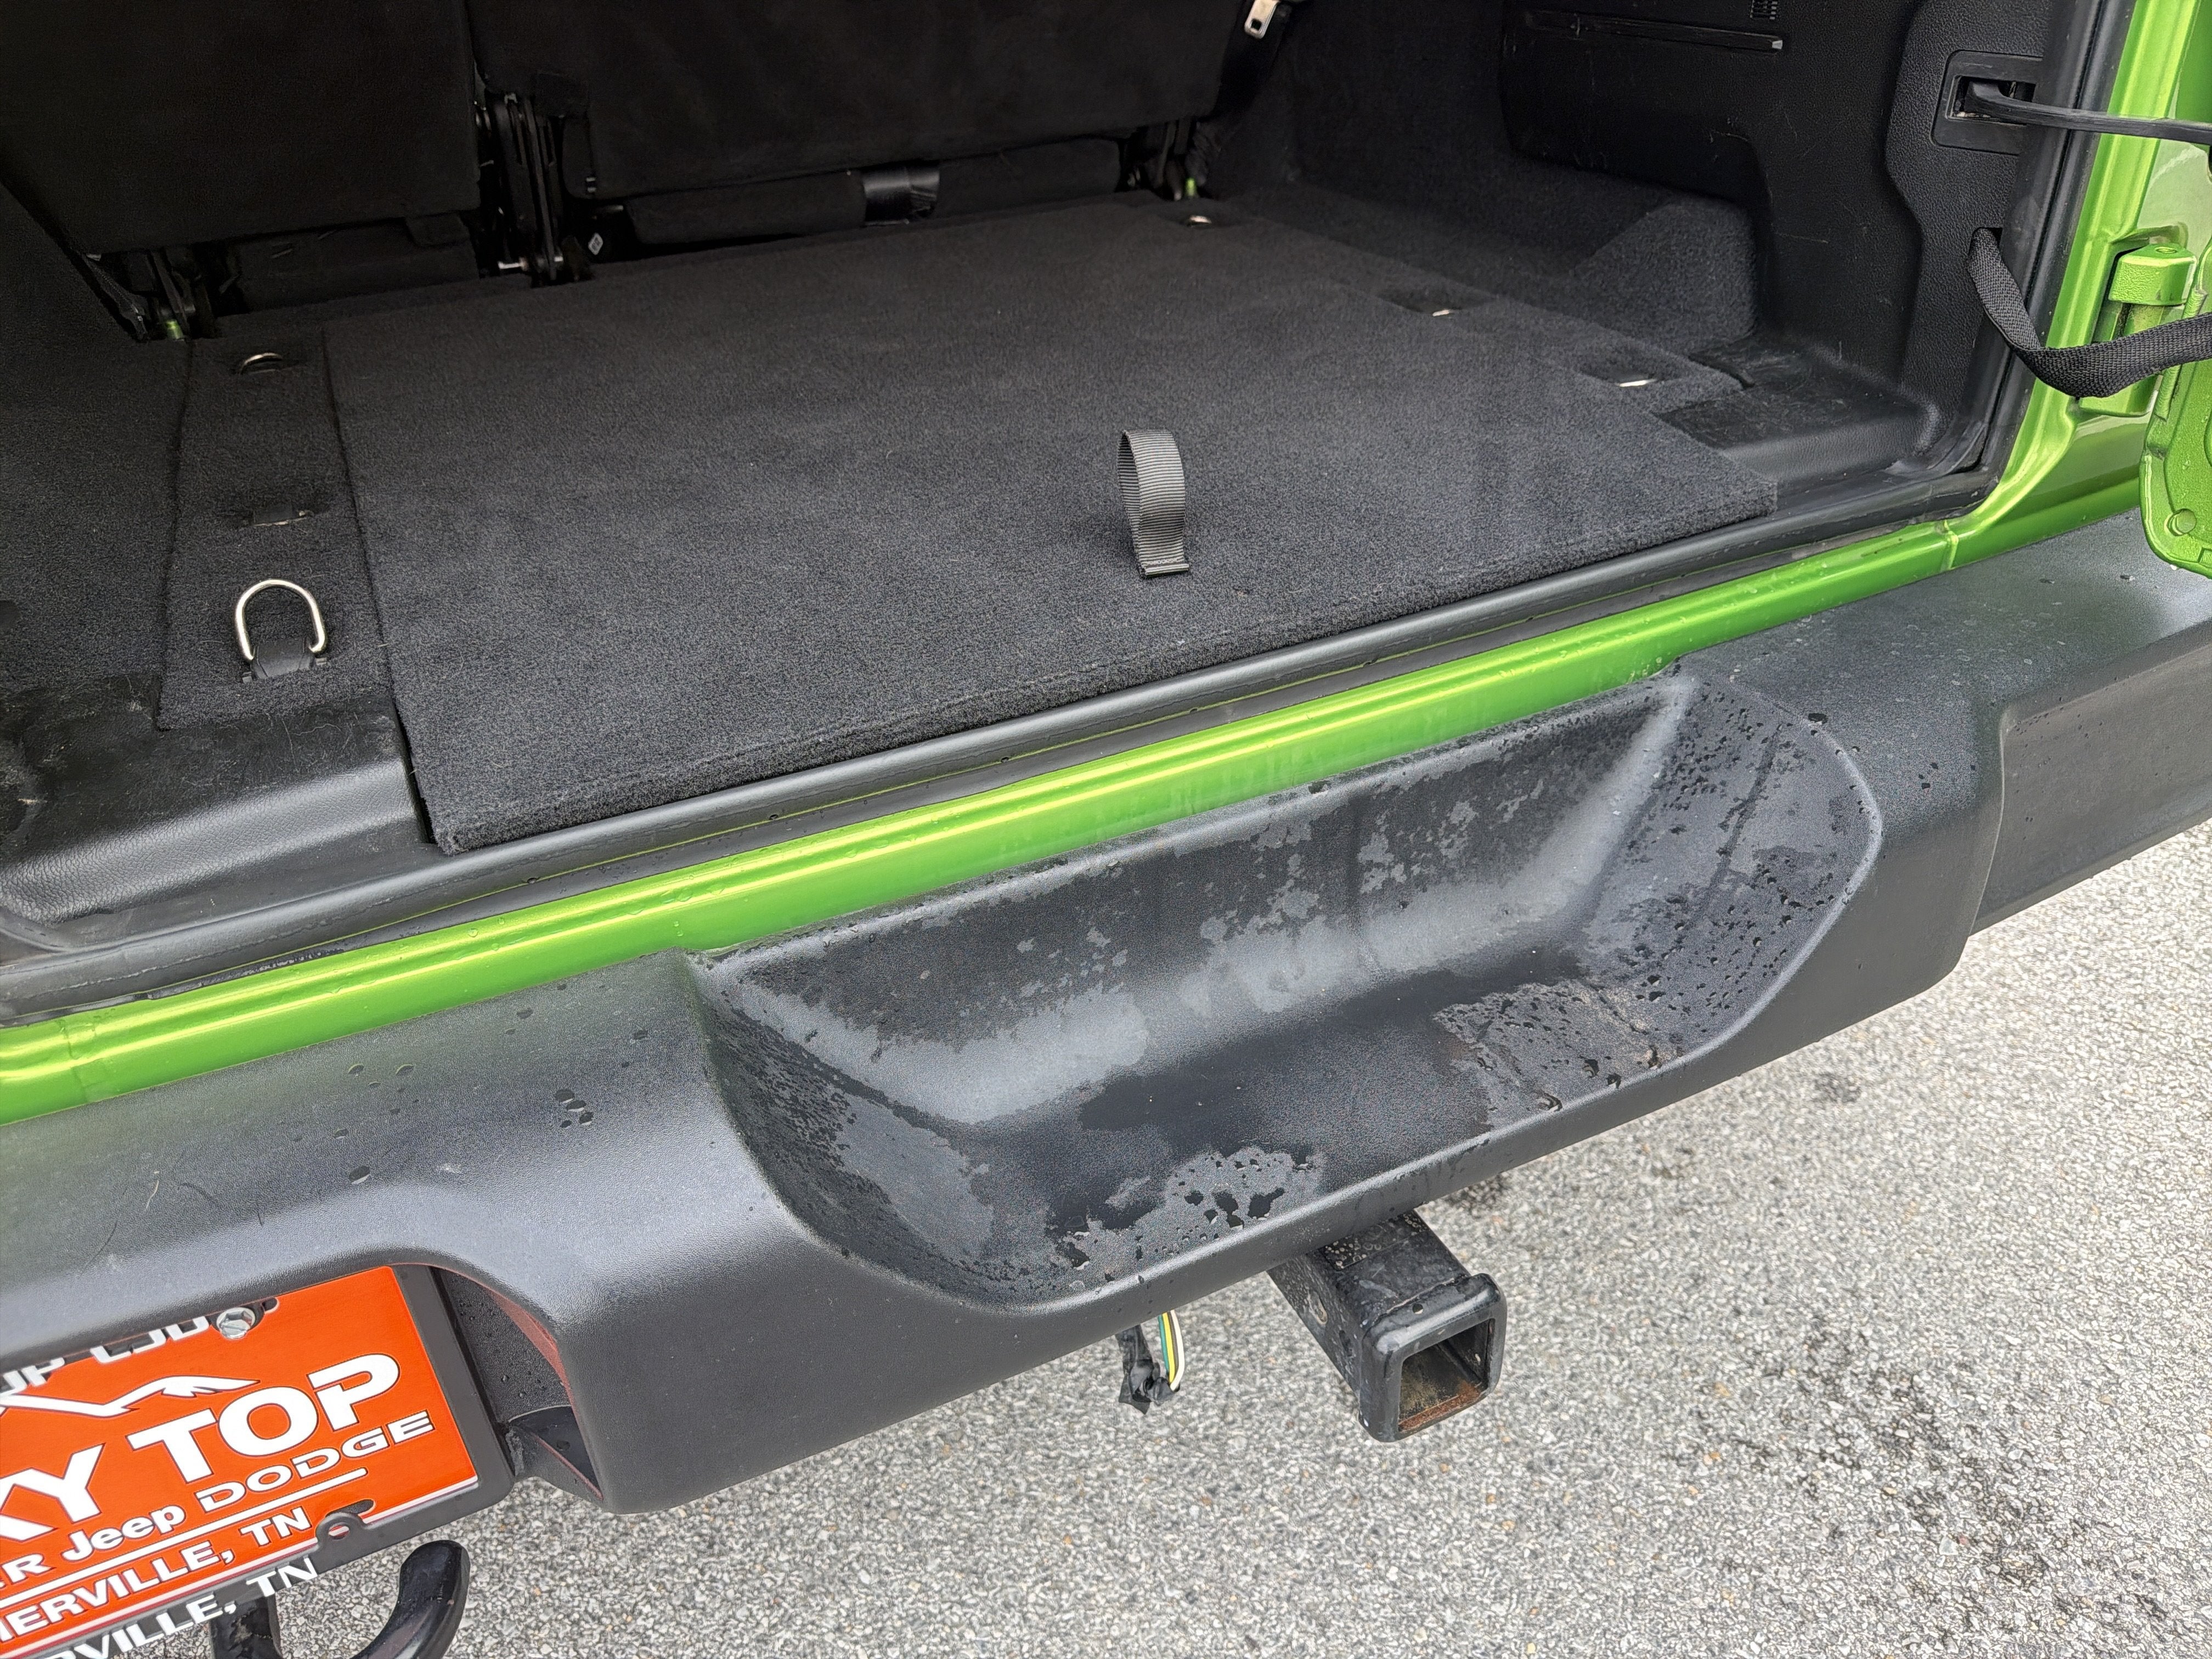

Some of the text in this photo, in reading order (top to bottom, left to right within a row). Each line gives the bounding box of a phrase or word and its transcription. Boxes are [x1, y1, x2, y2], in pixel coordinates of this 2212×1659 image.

[126, 1353, 401, 1484] TOP
[60, 1504, 187, 1561] Jeep
[193, 1409, 435, 1514] DODGE
[238, 1505, 313, 1548] TN
[45, 1556, 319, 1659] VILLE, TN
